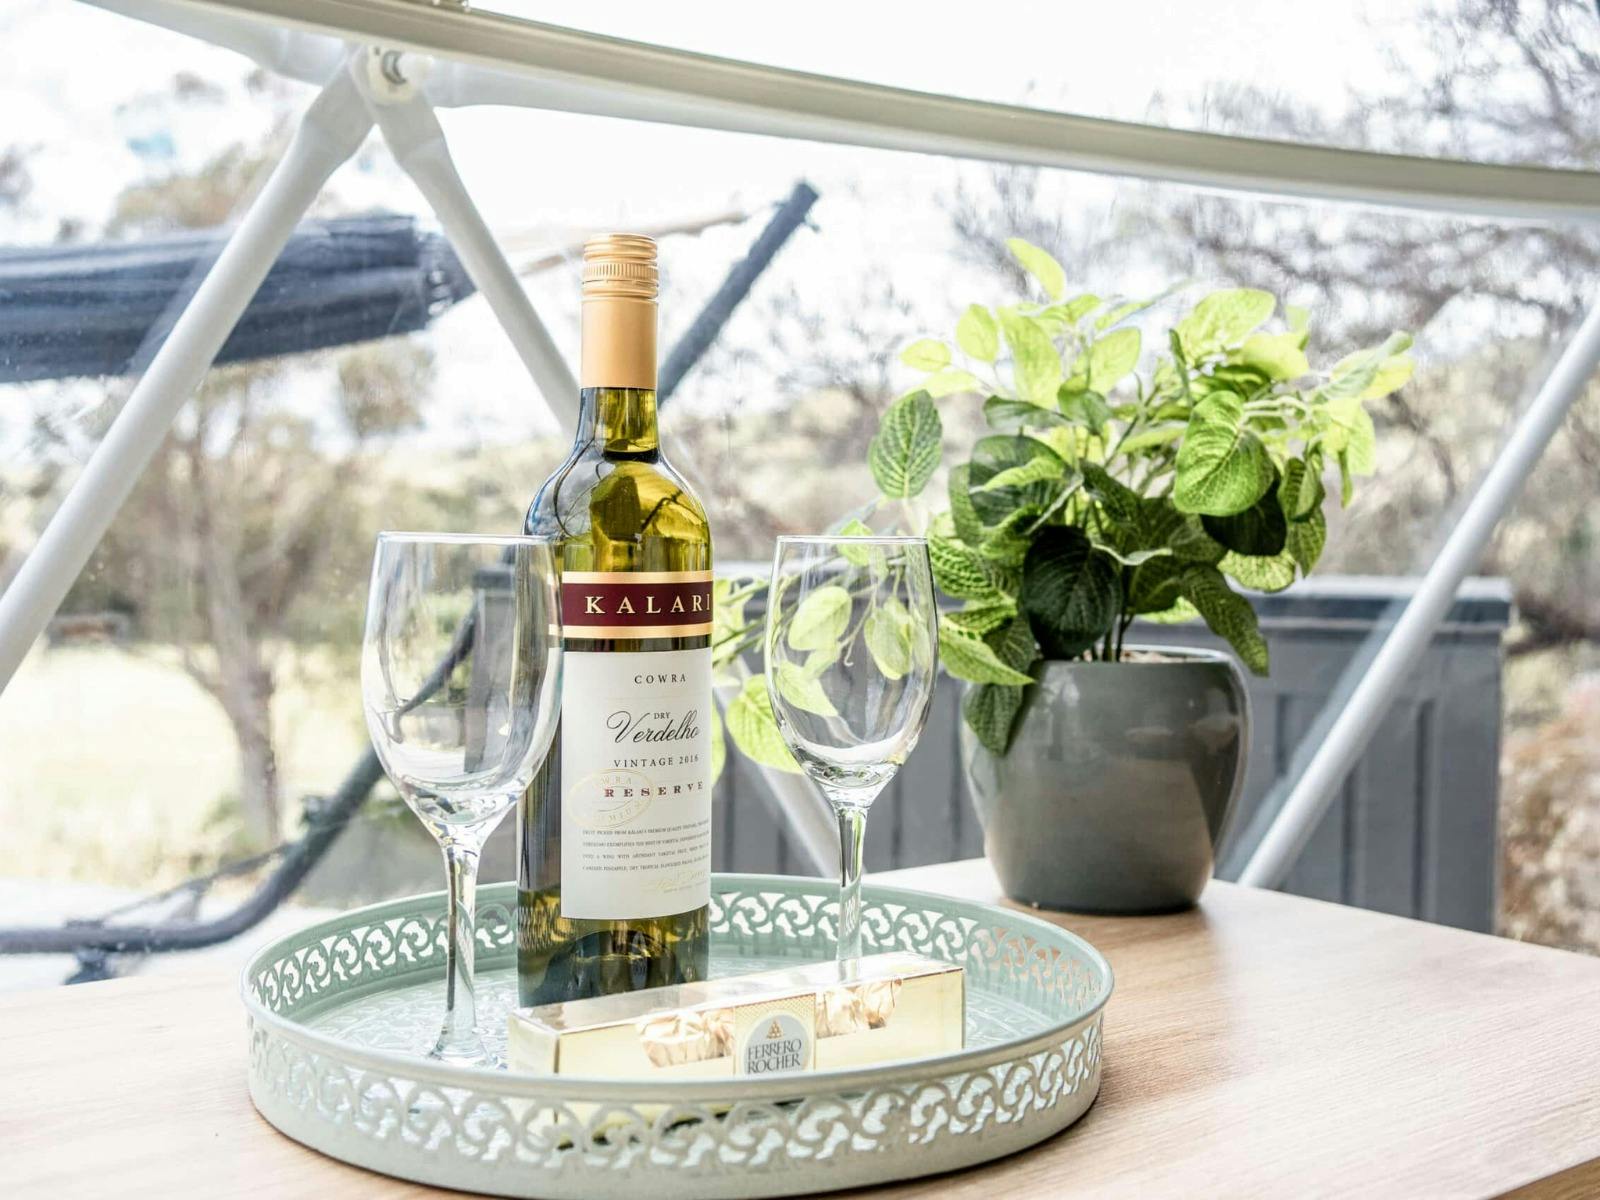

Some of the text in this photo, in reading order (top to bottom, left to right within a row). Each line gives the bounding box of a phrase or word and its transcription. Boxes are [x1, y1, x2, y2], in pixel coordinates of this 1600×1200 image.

[584, 593, 711, 614] KALARI
[634, 673, 687, 684] COWRA
[654, 711, 671, 720] DRY
[606, 709, 700, 744] Verdelho
[614, 753, 699, 768] VINTAGE 2016
[604, 780, 703, 798] RESERVE
[747, 1038, 802, 1061] FERRERO
[747, 1053, 801, 1074] ROCHER
